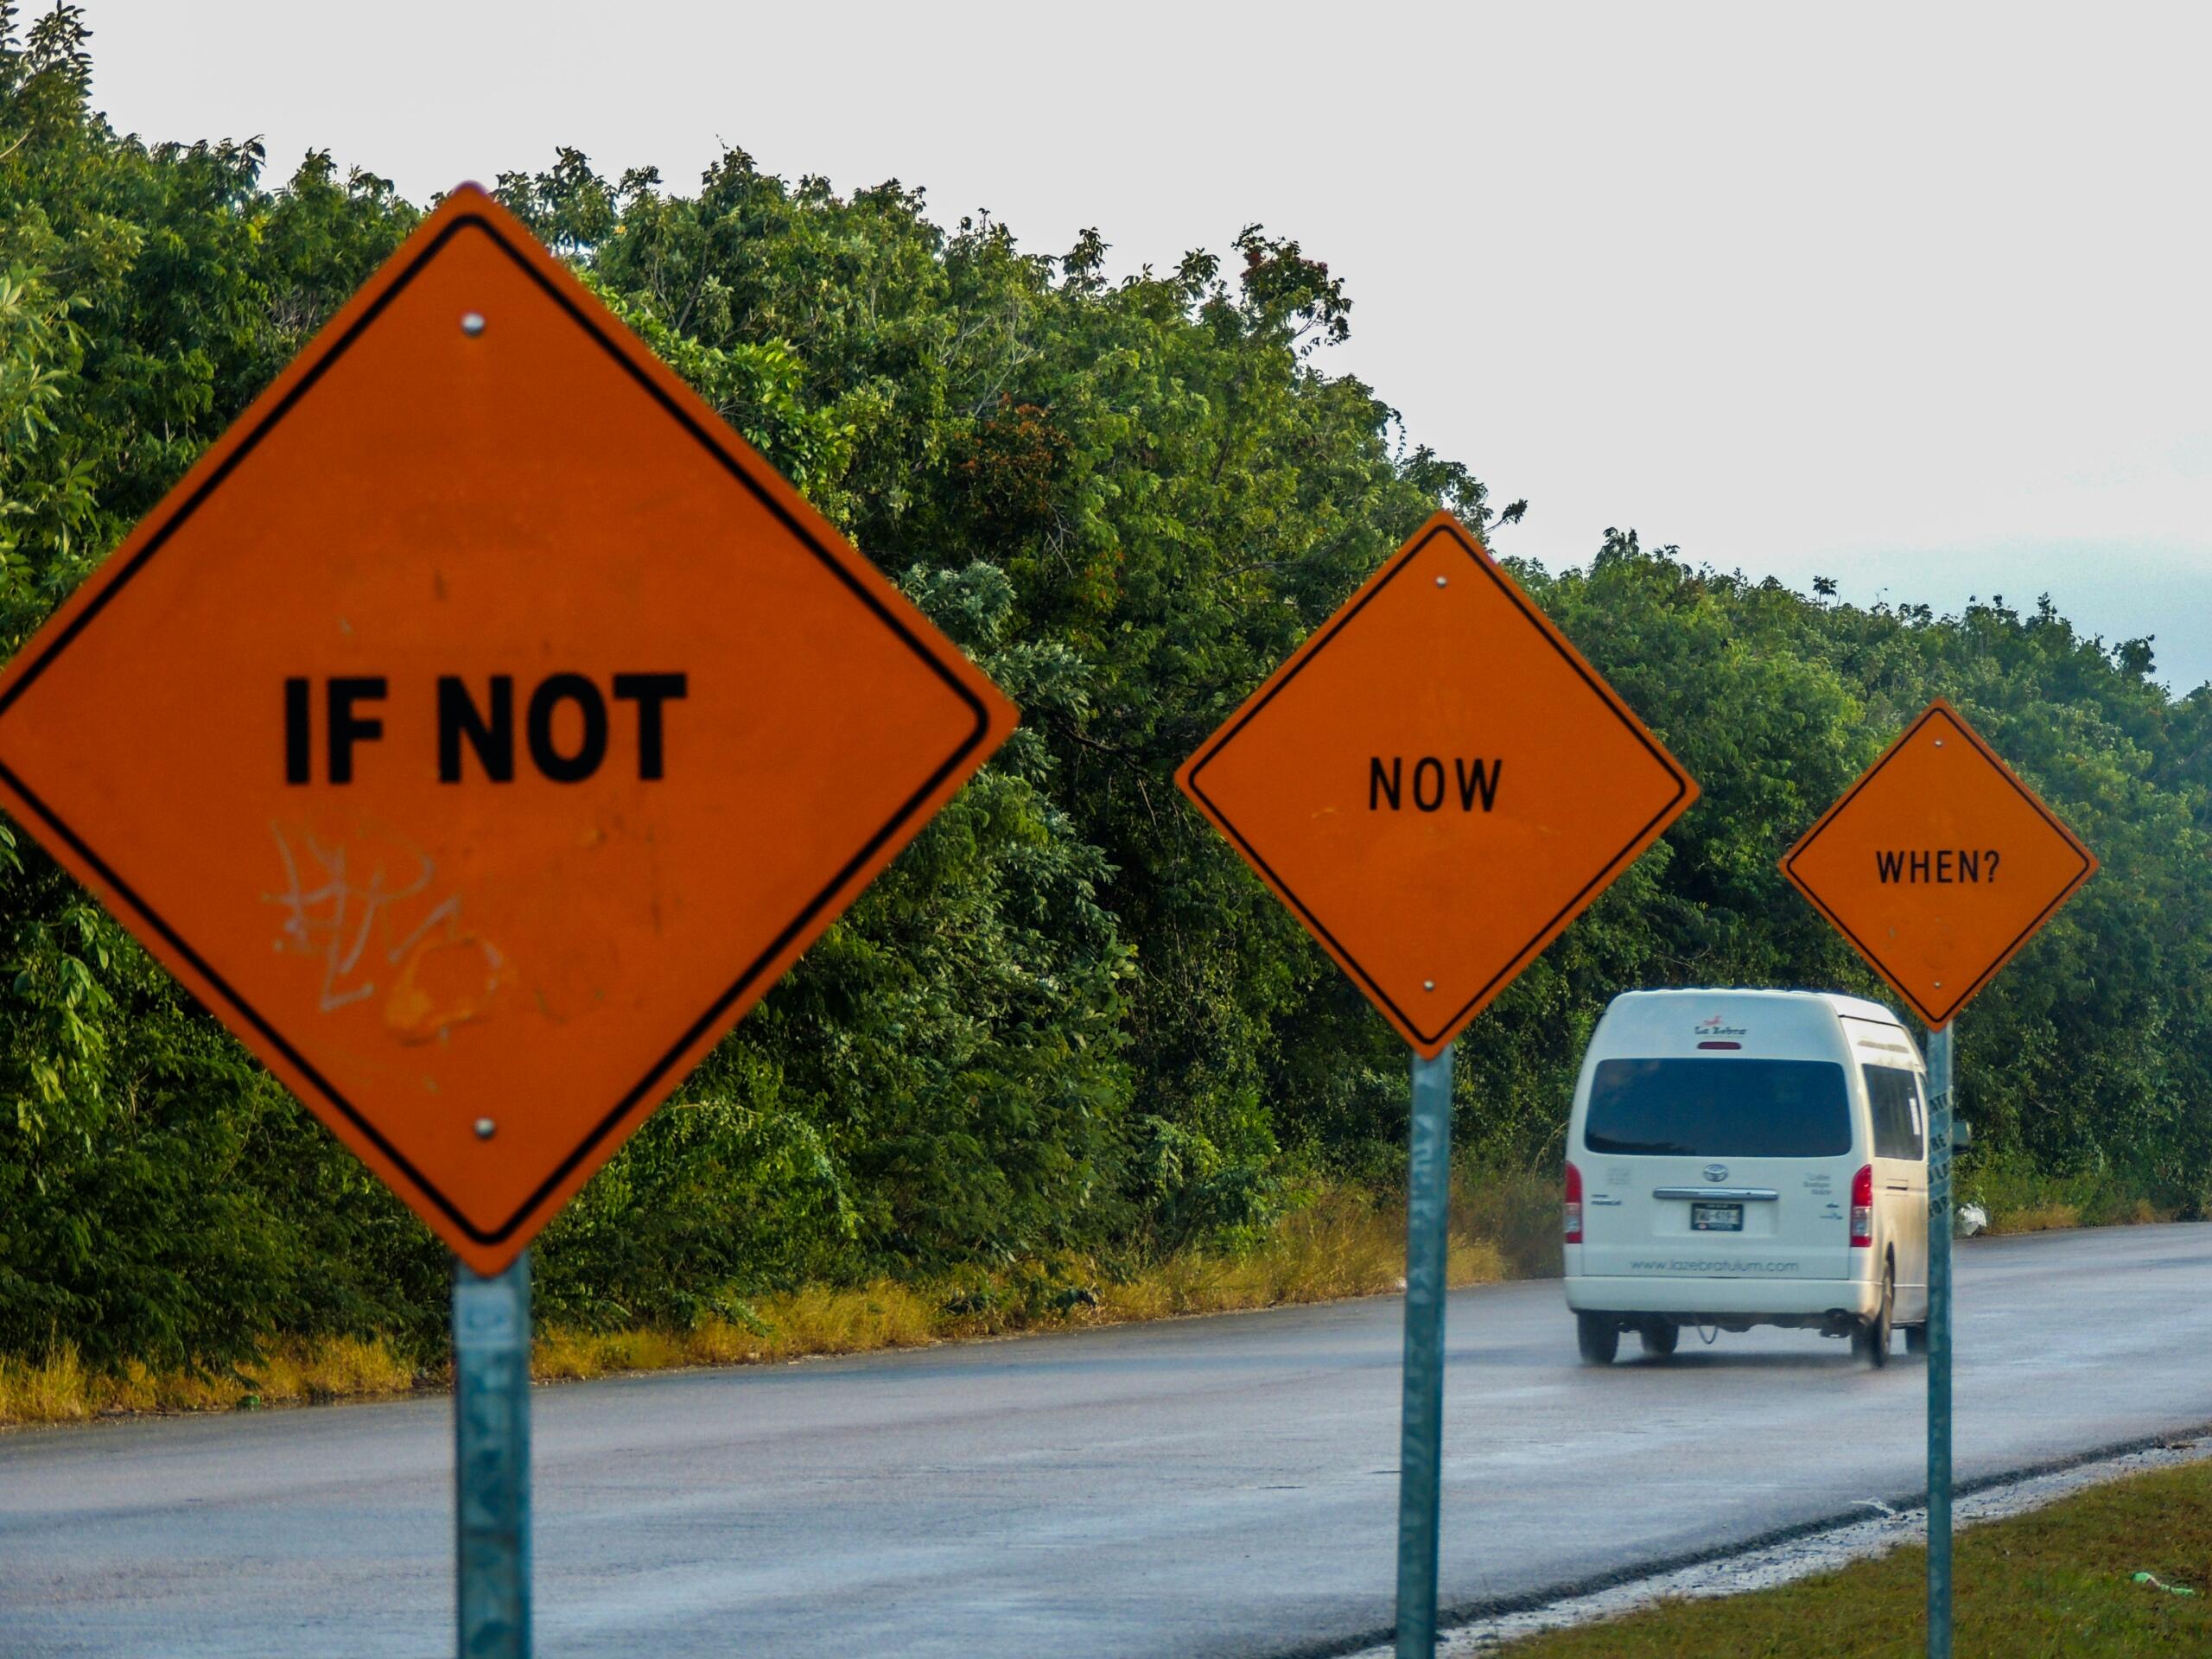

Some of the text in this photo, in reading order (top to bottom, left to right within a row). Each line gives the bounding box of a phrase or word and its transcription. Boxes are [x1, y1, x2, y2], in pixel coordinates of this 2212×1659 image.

[283, 671, 688, 786] IF NOT
[1369, 756, 1503, 813] NOW
[1876, 849, 2000, 884] WHEN?
[1630, 1258, 1799, 1272] www.lazebratulum.com
